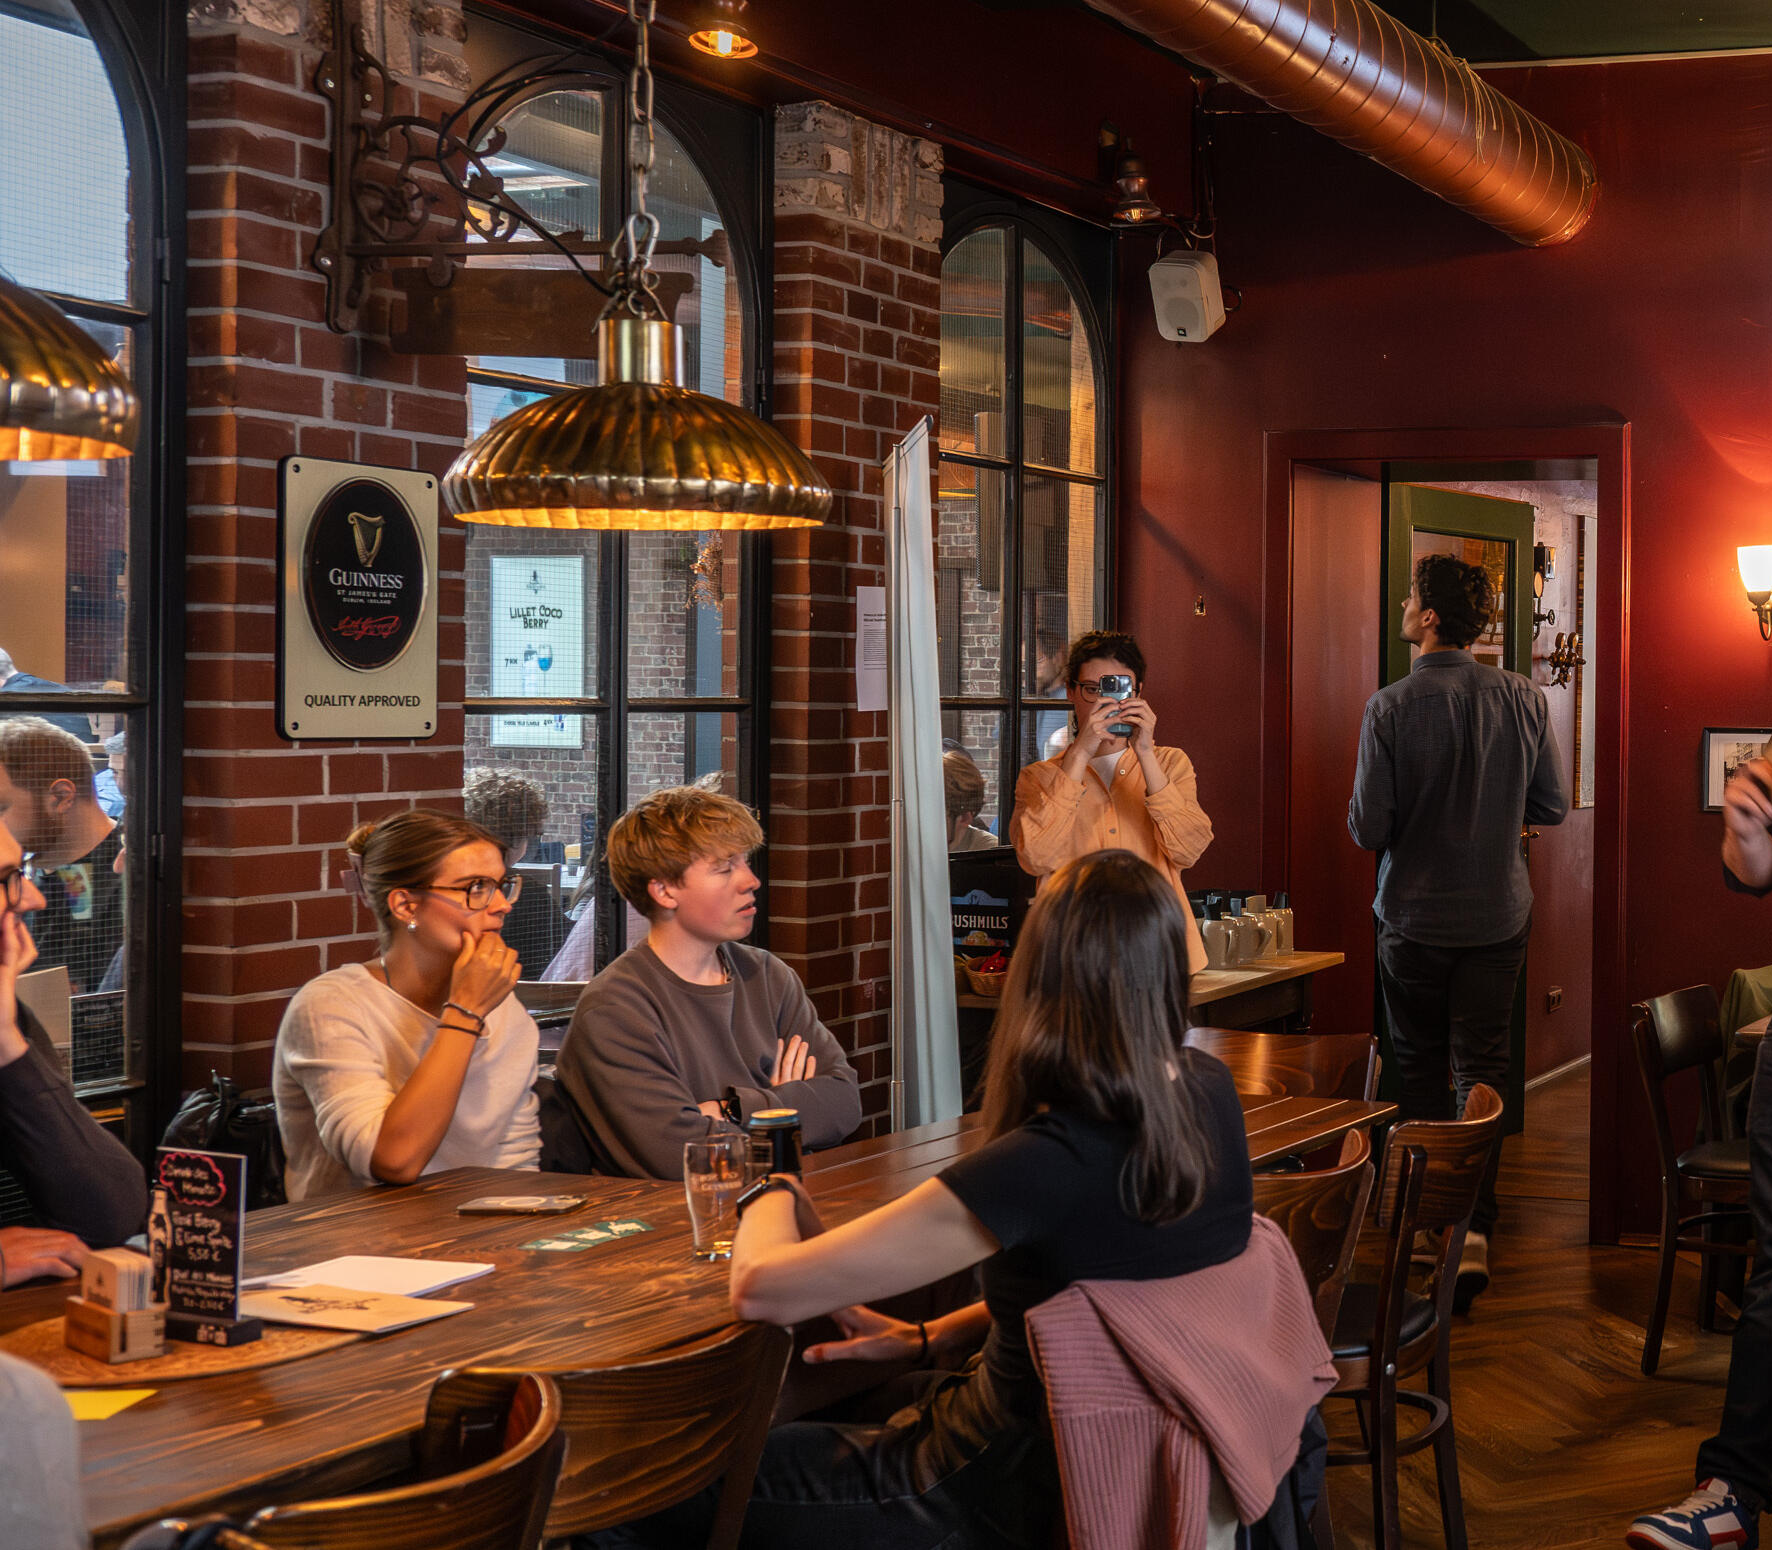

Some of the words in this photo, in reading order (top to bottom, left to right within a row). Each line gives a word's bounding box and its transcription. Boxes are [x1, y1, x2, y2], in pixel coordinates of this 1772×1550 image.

[328, 567, 404, 590] GUINNESS
[509, 606, 537, 619] LILLET
[539, 604, 563, 619] COCO
[523, 617, 549, 630] BERRY
[304, 694, 356, 708] QUALITY
[358, 694, 421, 707] APPROVED
[953, 914, 1009, 929] USHMILLS
